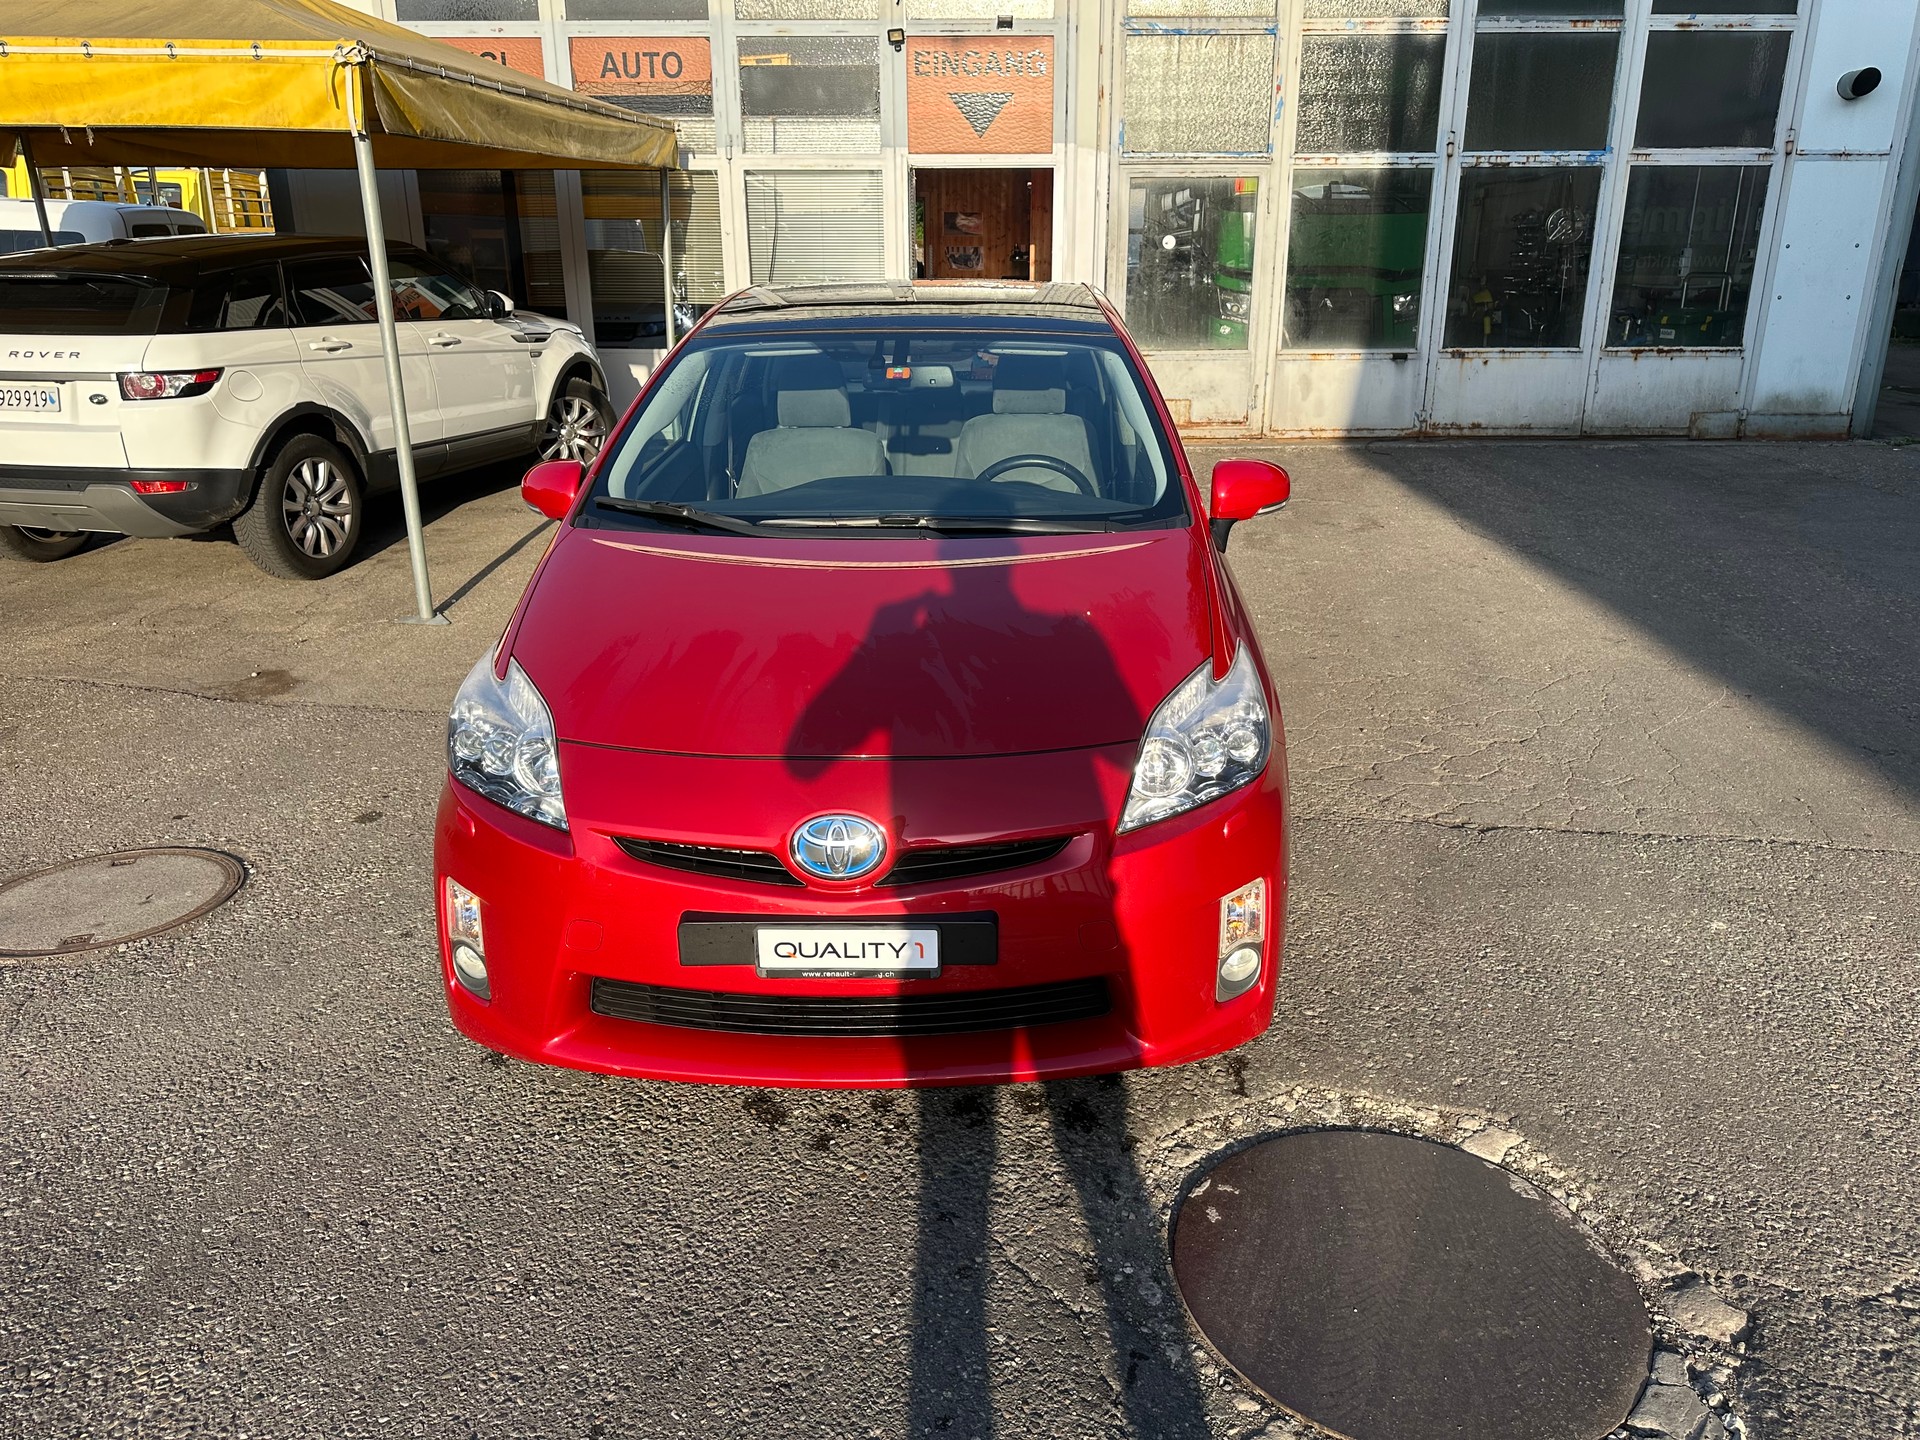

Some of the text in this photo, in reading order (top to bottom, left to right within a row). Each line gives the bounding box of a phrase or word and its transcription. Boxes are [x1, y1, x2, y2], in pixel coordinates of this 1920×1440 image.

[600, 51, 684, 79] AUTO
[913, 48, 1047, 78] EINGANG
[8, 350, 81, 359] ROVER
[774, 941, 908, 959] QUALITY
